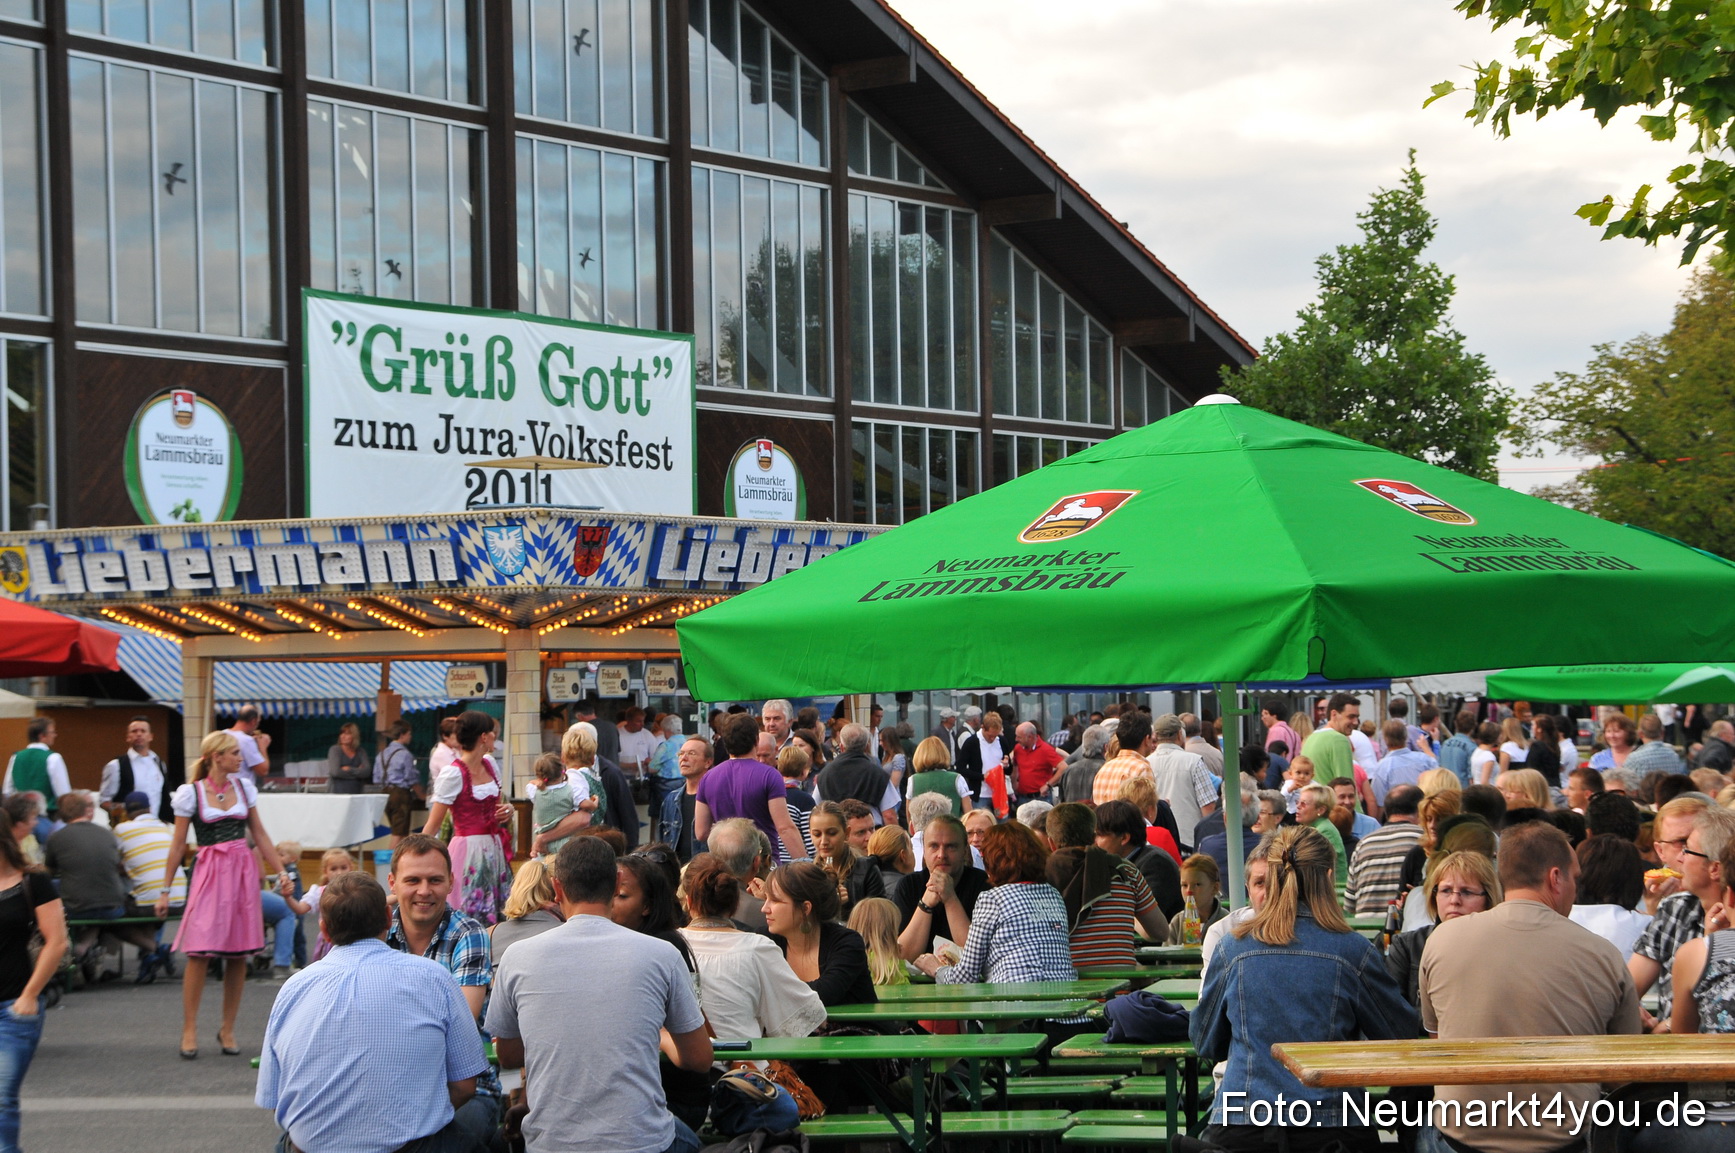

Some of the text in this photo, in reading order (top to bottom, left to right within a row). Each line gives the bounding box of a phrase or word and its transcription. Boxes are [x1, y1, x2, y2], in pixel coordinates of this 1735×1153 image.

[155, 431, 214, 447] Neumarkter
[334, 413, 674, 471] zum Jura-Volksfest
[145, 445, 224, 466] Lammsbräu
[465, 467, 553, 510] 2011
[745, 474, 786, 487] Neumarkter
[738, 485, 793, 502] Lammsbräu
[1413, 533, 1571, 550] Neumarkter
[28, 537, 459, 595] Liebermann
[922, 549, 1121, 575] Neumarkter
[1417, 549, 1643, 574] Lammsbräu
[857, 566, 1128, 603] Lammsbräu
